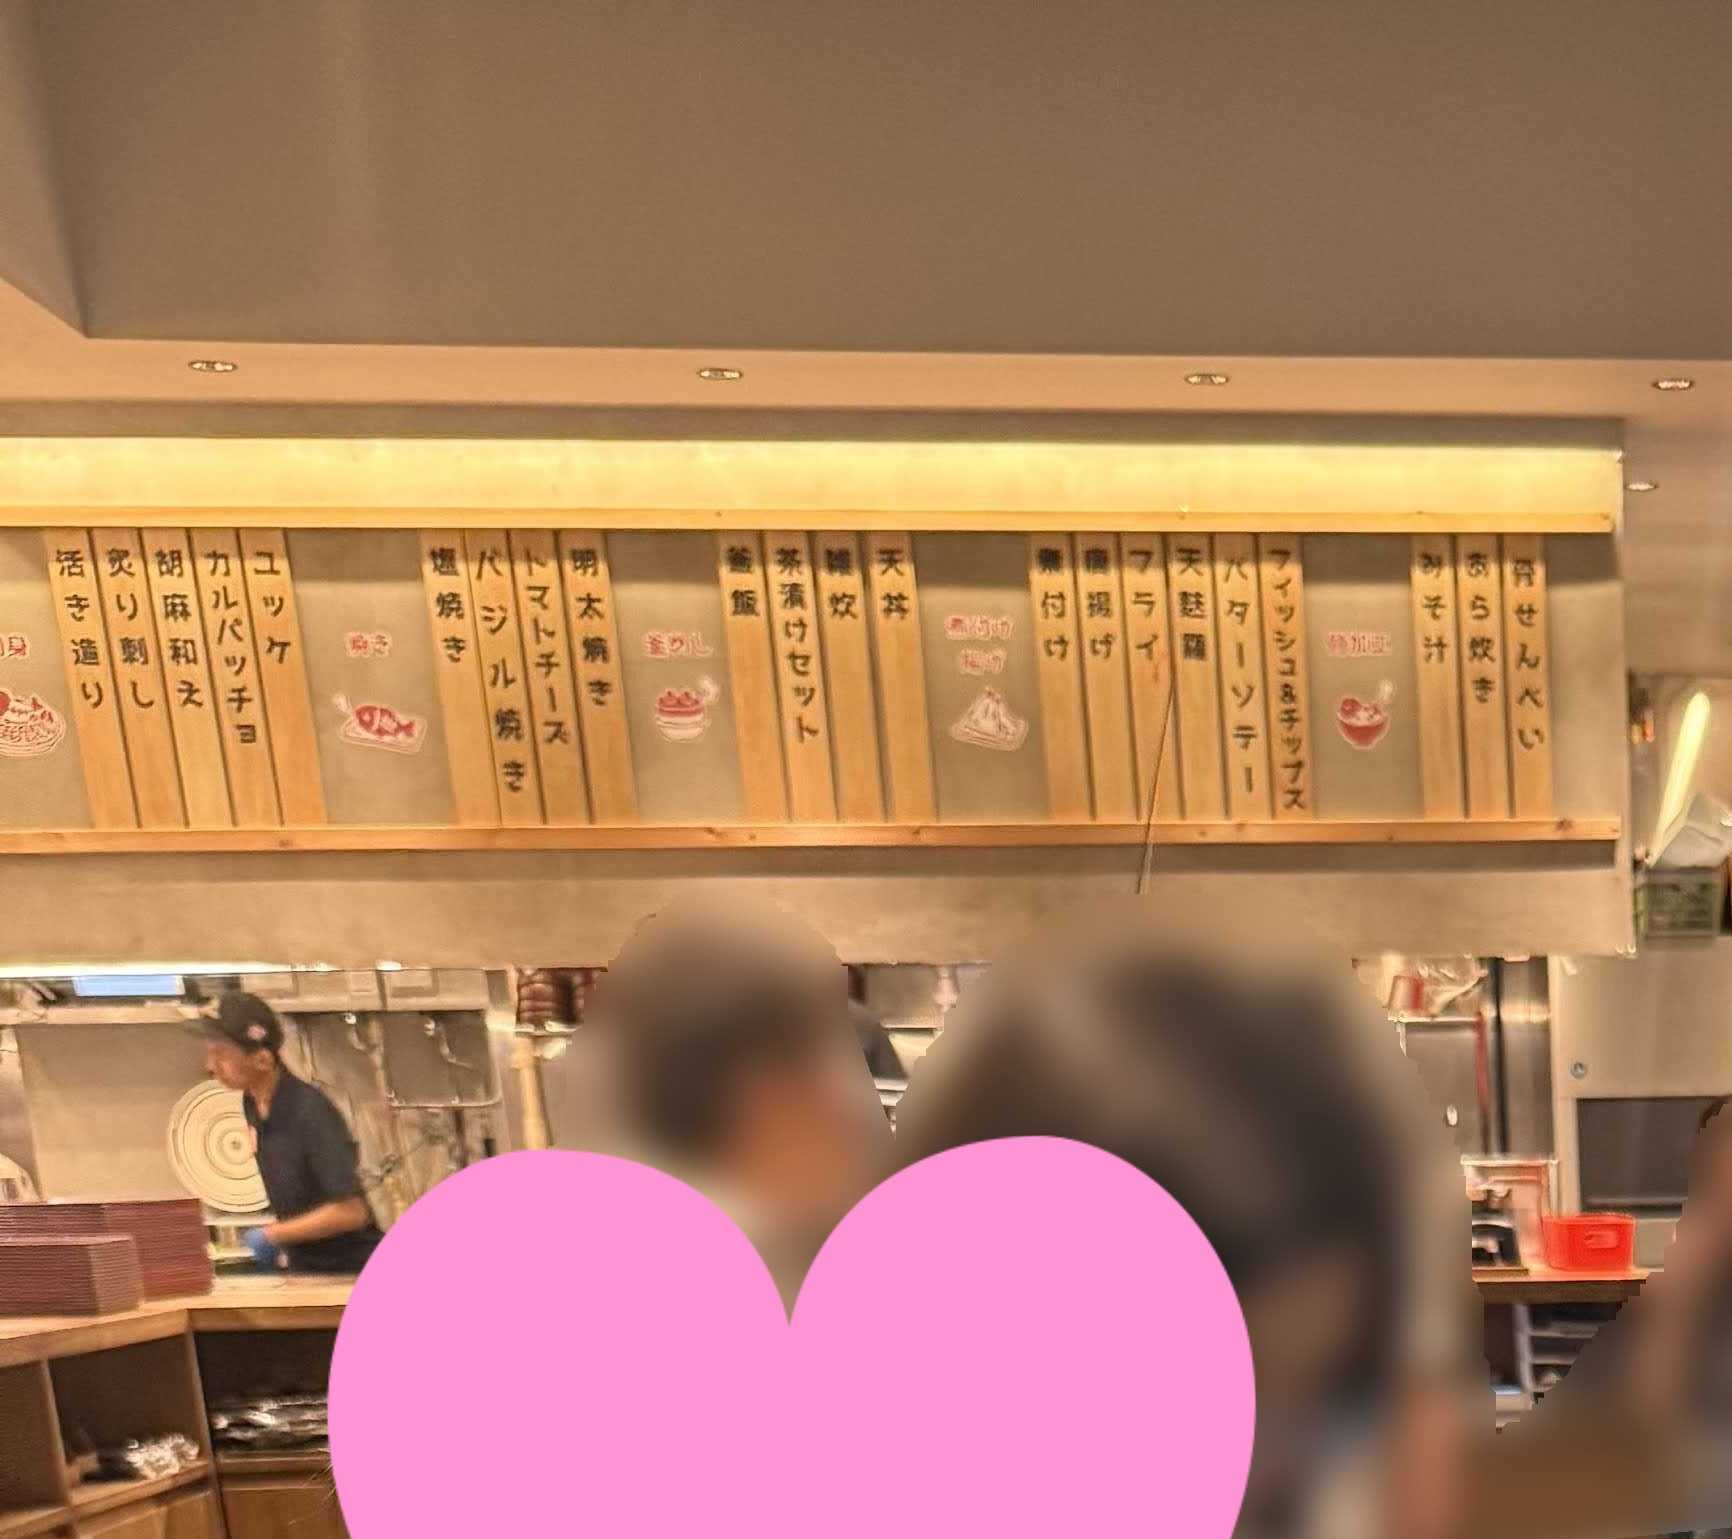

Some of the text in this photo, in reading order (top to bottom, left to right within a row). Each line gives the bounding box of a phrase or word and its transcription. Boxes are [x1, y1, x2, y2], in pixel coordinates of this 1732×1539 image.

[55, 549, 103, 709] 活き造り
[156, 549, 203, 708] 胡麻和え
[204, 550, 256, 744] カルパッチョ
[254, 550, 291, 664] ユッケ
[476, 548, 525, 793] バジル焼き
[1130, 549, 1157, 660] フライ
[1224, 556, 1257, 792] バターソテー
[1419, 552, 1447, 664] みそ汁
